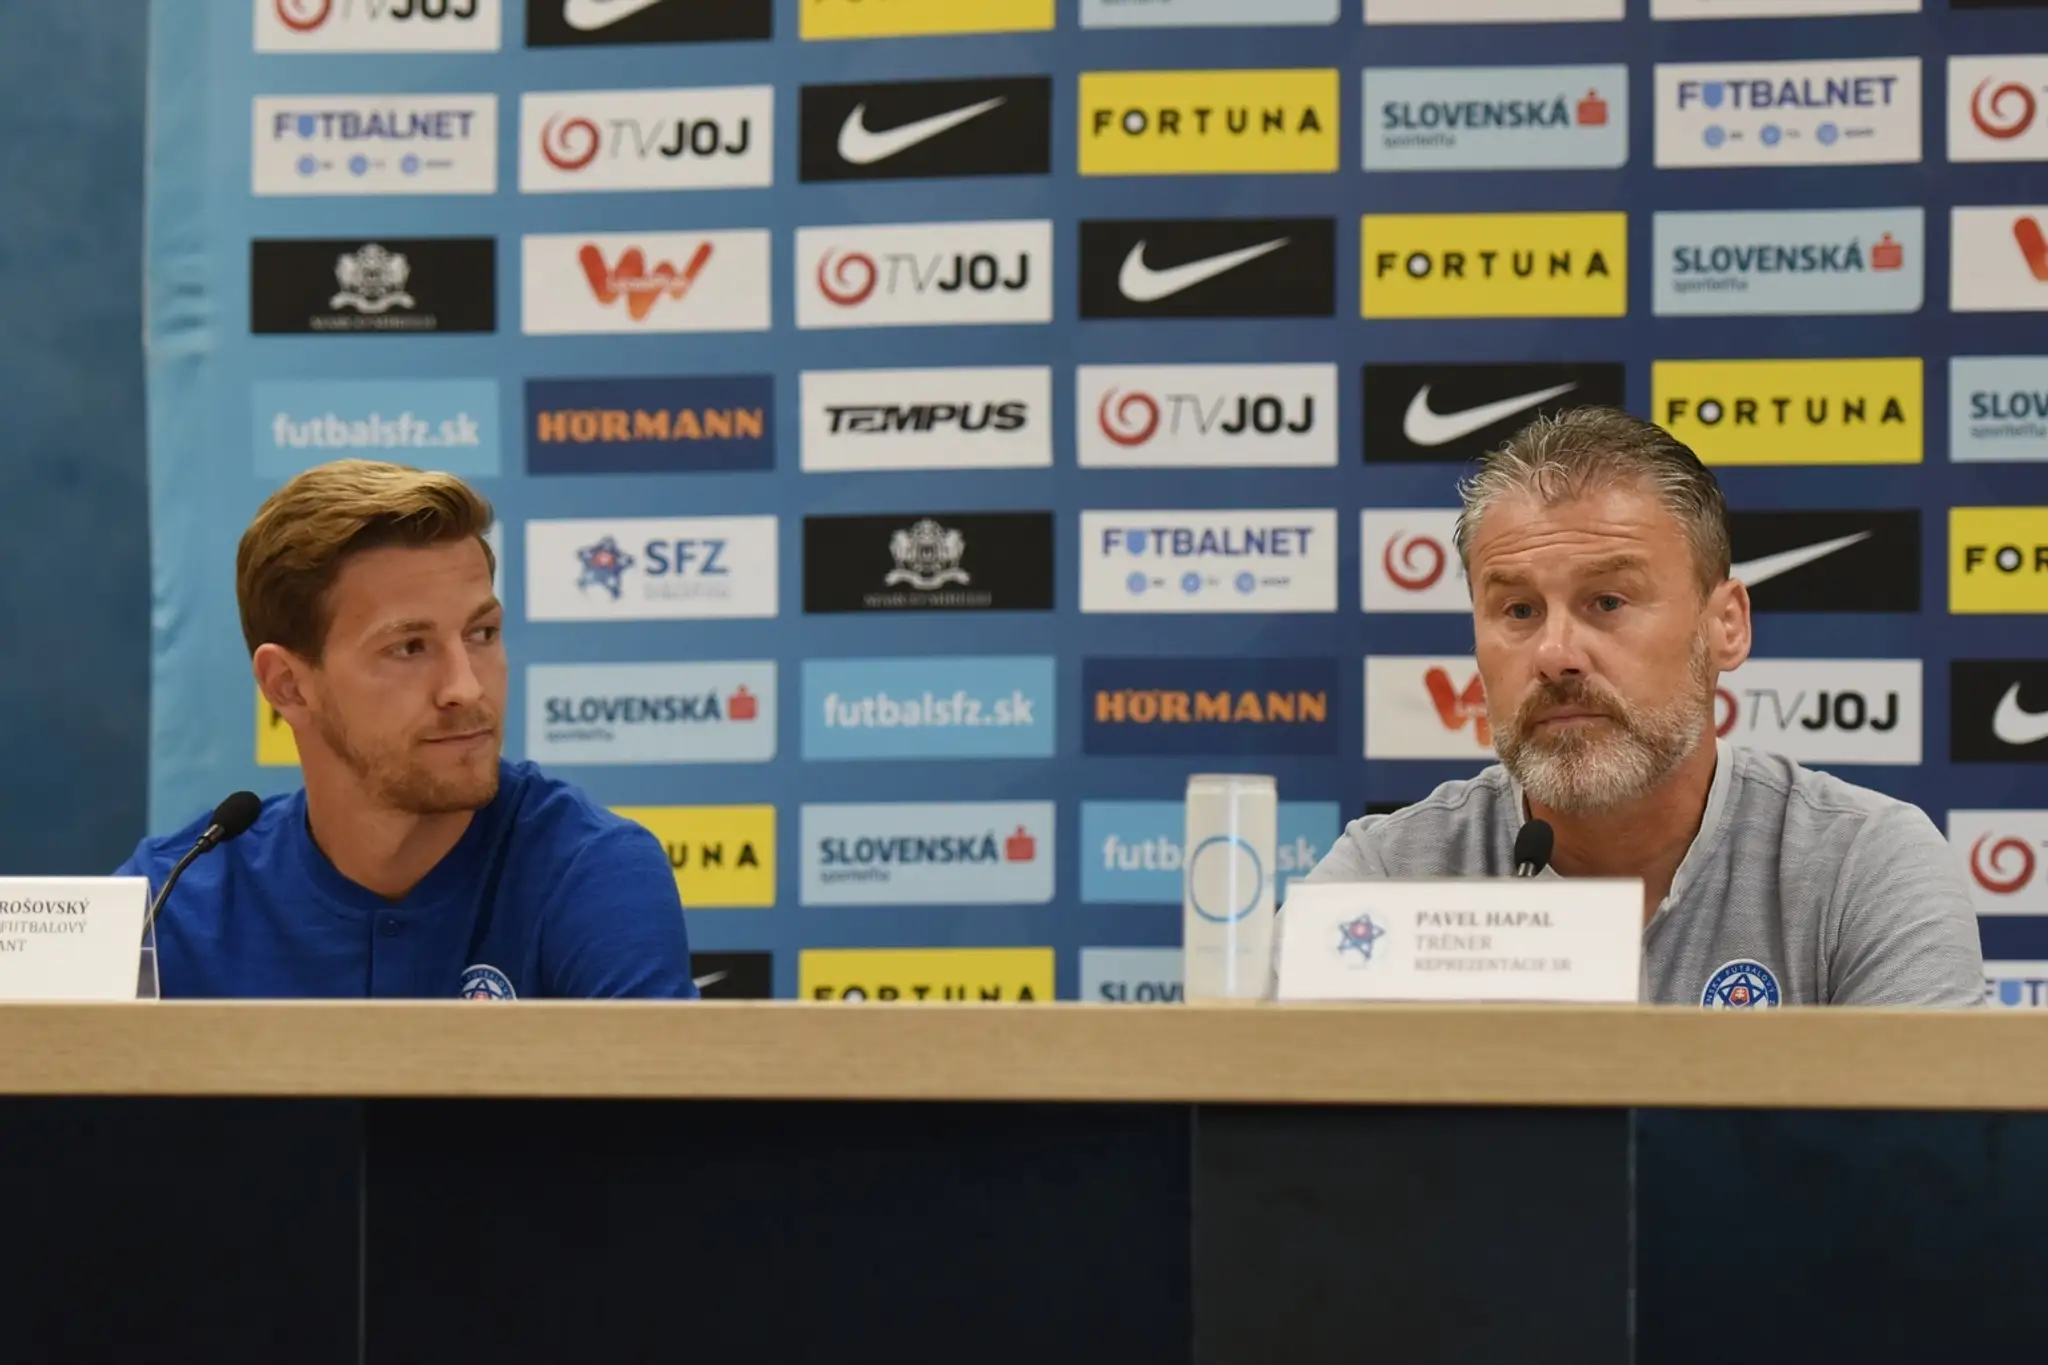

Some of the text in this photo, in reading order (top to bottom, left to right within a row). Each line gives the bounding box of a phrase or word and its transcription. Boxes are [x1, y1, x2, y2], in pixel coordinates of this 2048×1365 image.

[1093, 107, 1322, 136] FORTUNA
[1383, 93, 1570, 129] SLOVENSKÁ
[1376, 252, 1609, 279] FORTUNA
[1673, 237, 1864, 273] SLOVENSKÁ
[537, 408, 763, 442] HÖRMANN
[824, 402, 1027, 434] TEMPUS
[1668, 398, 1906, 425] FORTUNA
[273, 412, 479, 448] futbalsfz.sk
[644, 539, 728, 575] SFZ
[545, 687, 722, 723] SLOVENSKÁ
[823, 690, 1033, 728] futbalsfz.sk
[1096, 689, 1326, 723] HÖRMANN
[818, 833, 999, 865] SLOVENSKÁ
[1416, 912, 1553, 927] PAVEL HAPAL
